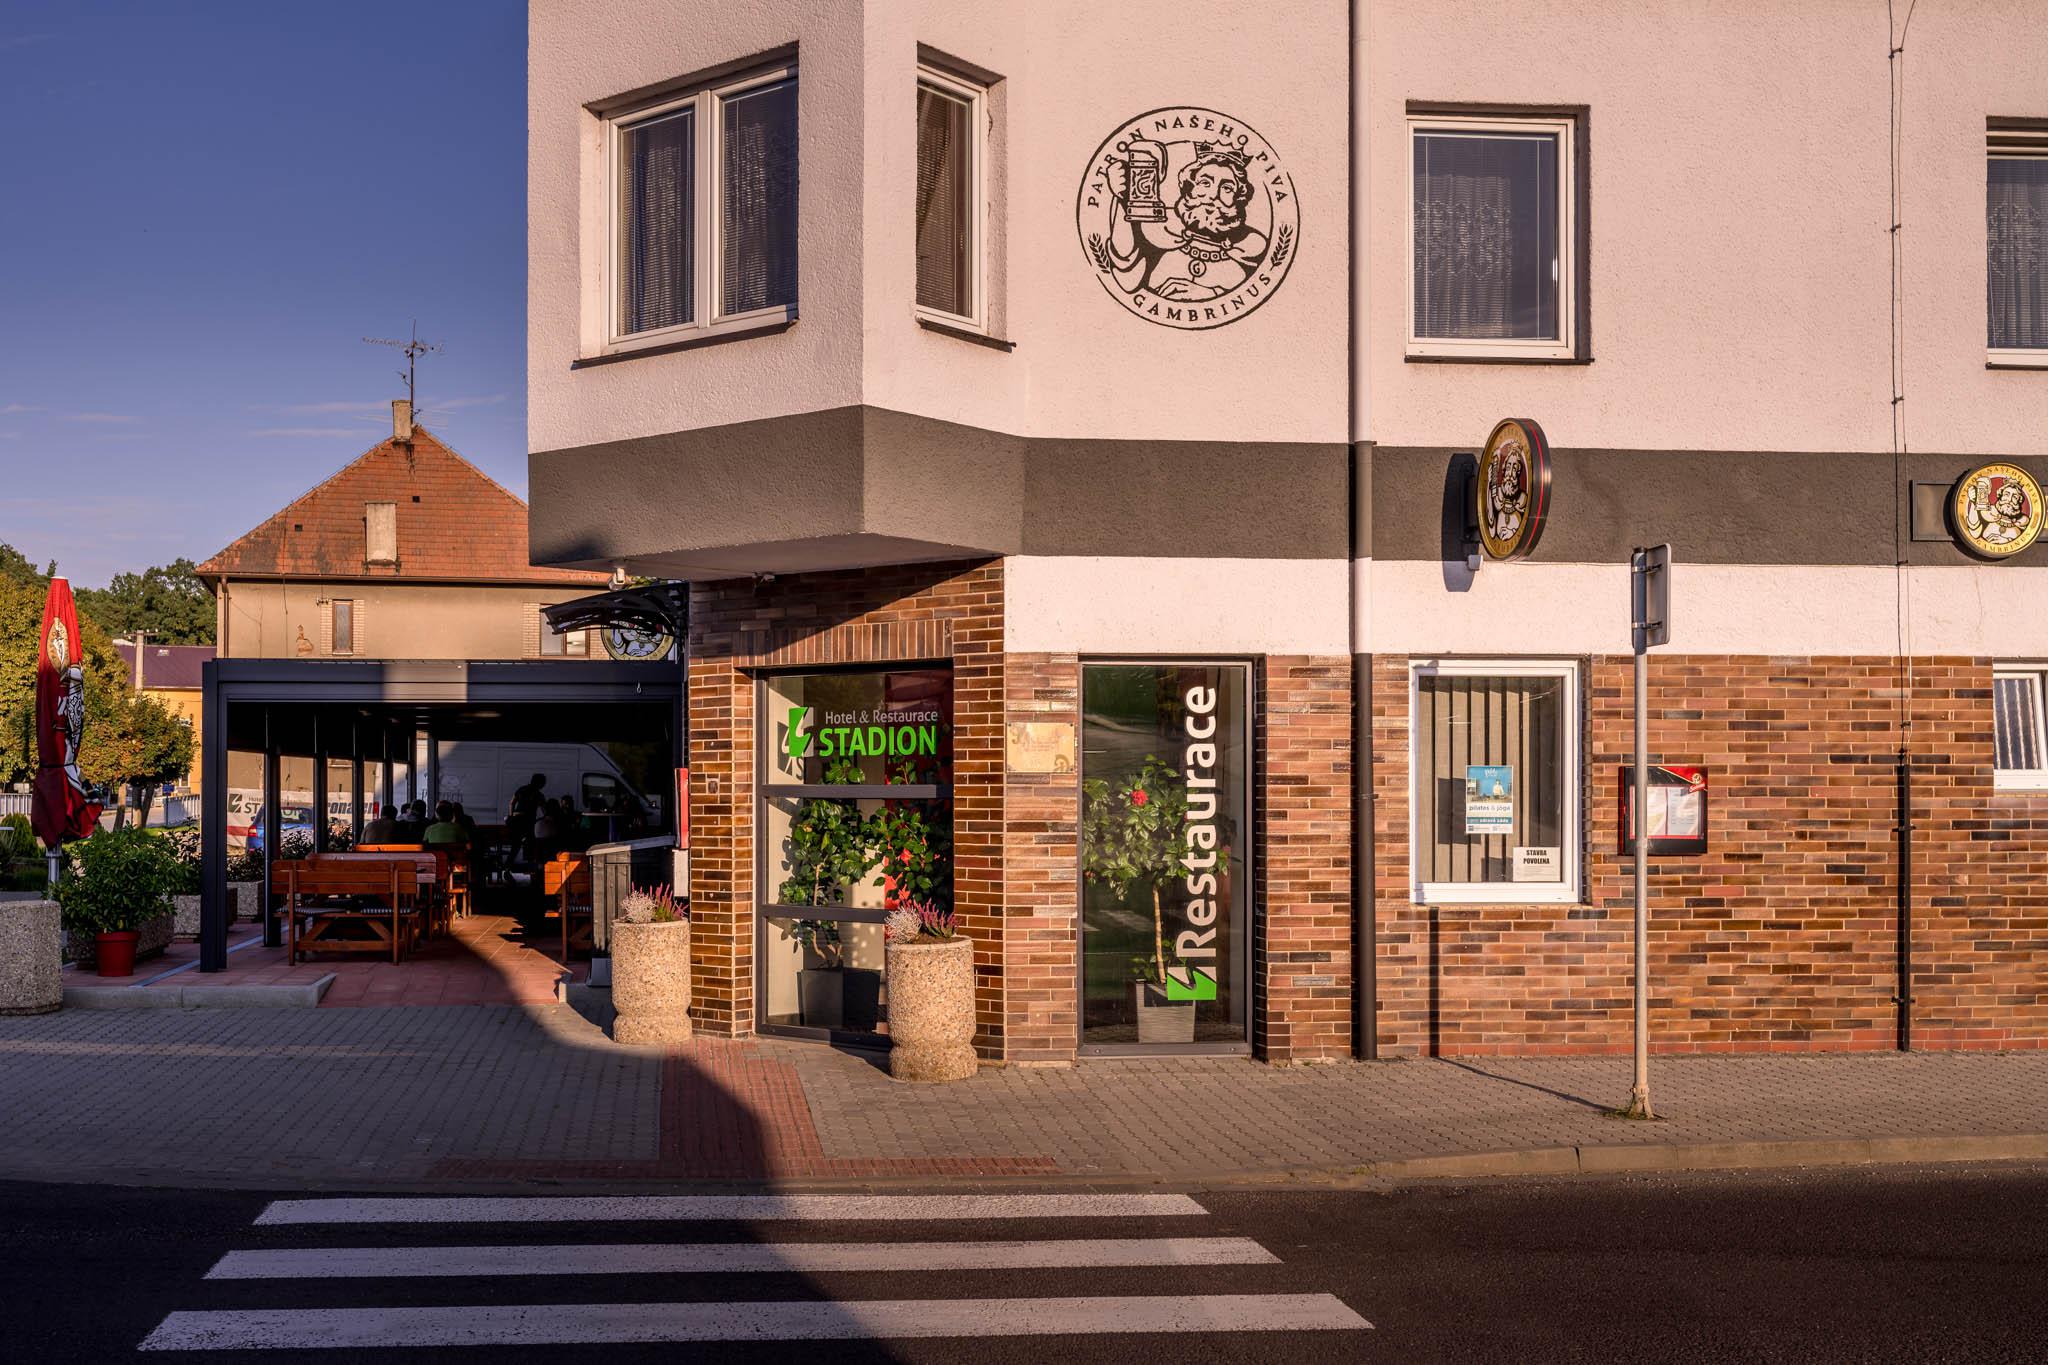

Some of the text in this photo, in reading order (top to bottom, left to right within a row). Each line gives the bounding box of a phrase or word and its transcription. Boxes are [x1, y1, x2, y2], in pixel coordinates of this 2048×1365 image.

[1087, 115, 1289, 209] PATRON NAŠEHO PIVA
[1132, 273, 1272, 322] GAMBRINUS
[825, 709, 938, 725] Hotel & Restaurace
[818, 725, 937, 757] STADION
[1175, 685, 1217, 958] Restaurace
[1523, 857, 1550, 865] POVOLENA
